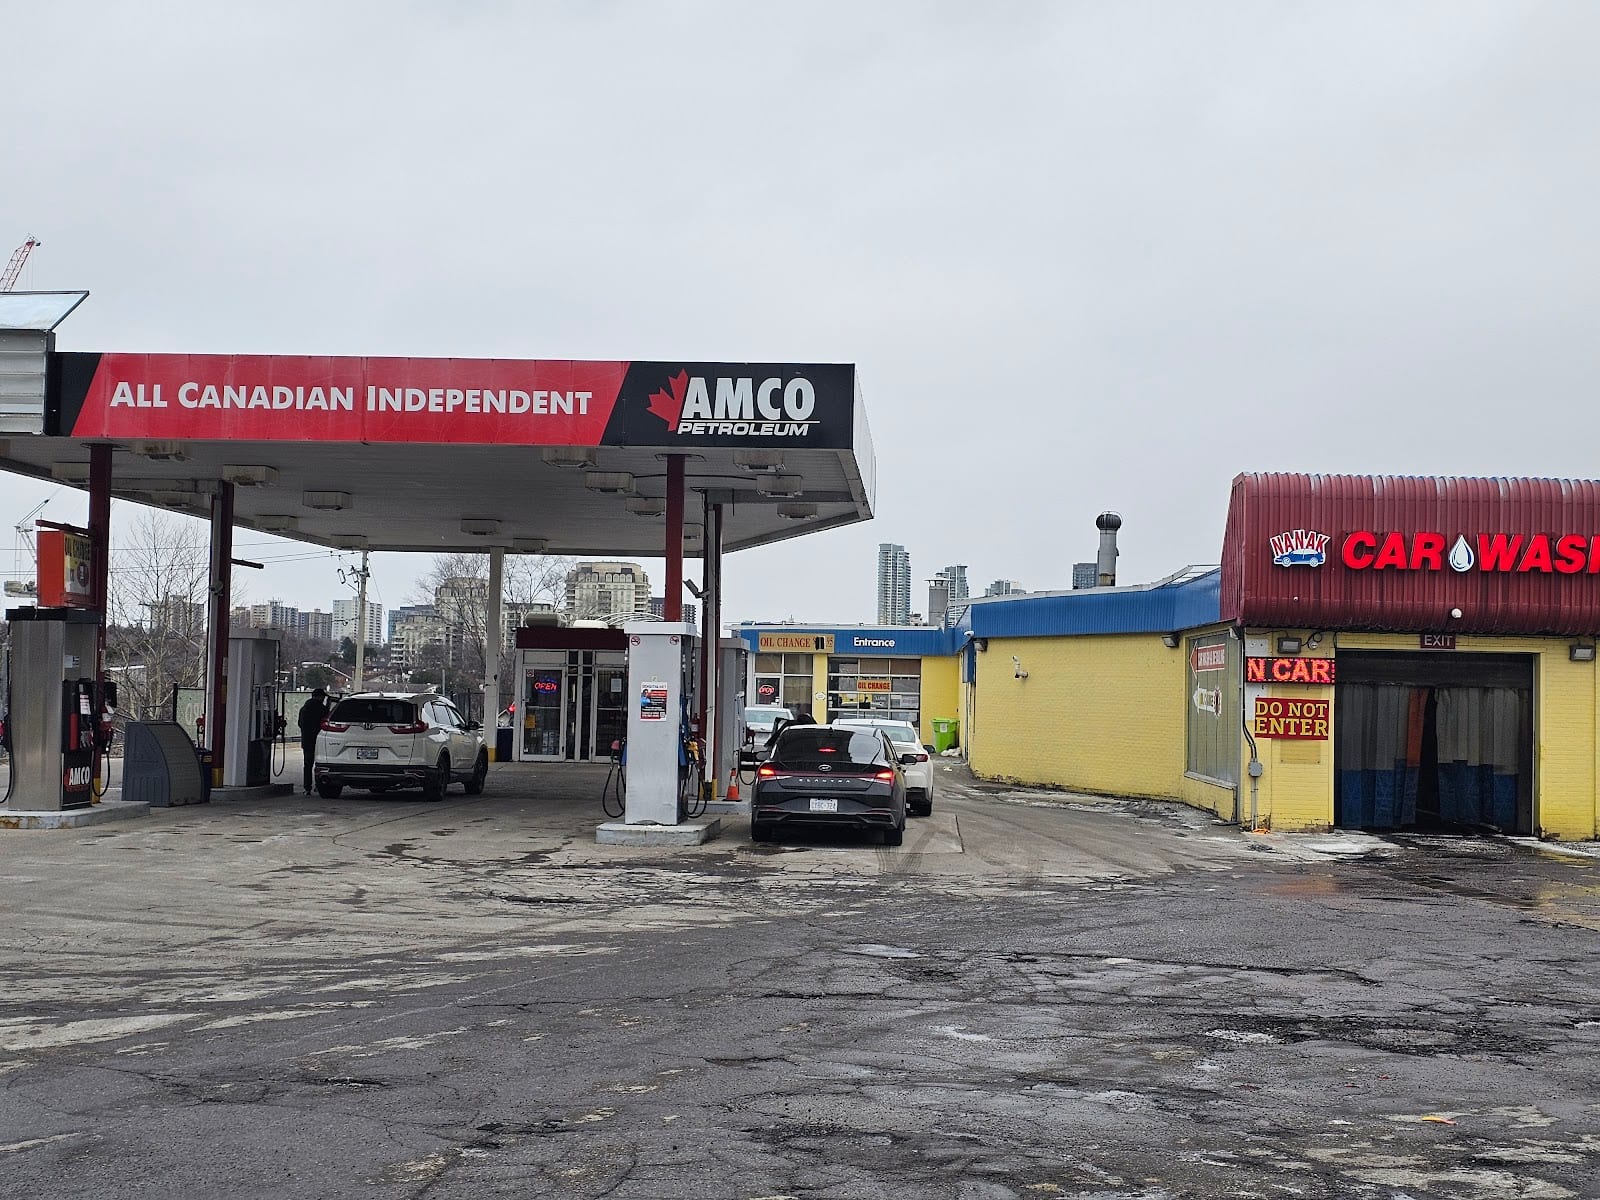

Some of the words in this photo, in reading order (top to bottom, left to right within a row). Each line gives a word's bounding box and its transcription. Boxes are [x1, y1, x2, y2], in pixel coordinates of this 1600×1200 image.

[110, 381, 168, 408] ALL
[177, 381, 354, 411] CANADIAN
[366, 385, 593, 415] INDEPENDENT
[681, 376, 816, 421] AMCO
[677, 422, 809, 436] PETROLEUM
[1270, 530, 1330, 557] NANAK
[1341, 530, 1446, 570] CAR
[760, 636, 775, 648] OIL
[777, 637, 811, 648] CHANGE
[853, 636, 896, 648] Entrance
[1423, 634, 1453, 647] EXIT
[1247, 657, 1266, 682] N
[1272, 657, 1331, 683] CAR
[534, 682, 558, 691] OPEN
[857, 681, 867, 690] OIL
[868, 681, 891, 690] CHANGE
[1255, 701, 1283, 716] DO
[1287, 702, 1328, 718] NOT
[1255, 716, 1329, 737] ENTER
[68, 766, 91, 786] AMCO
